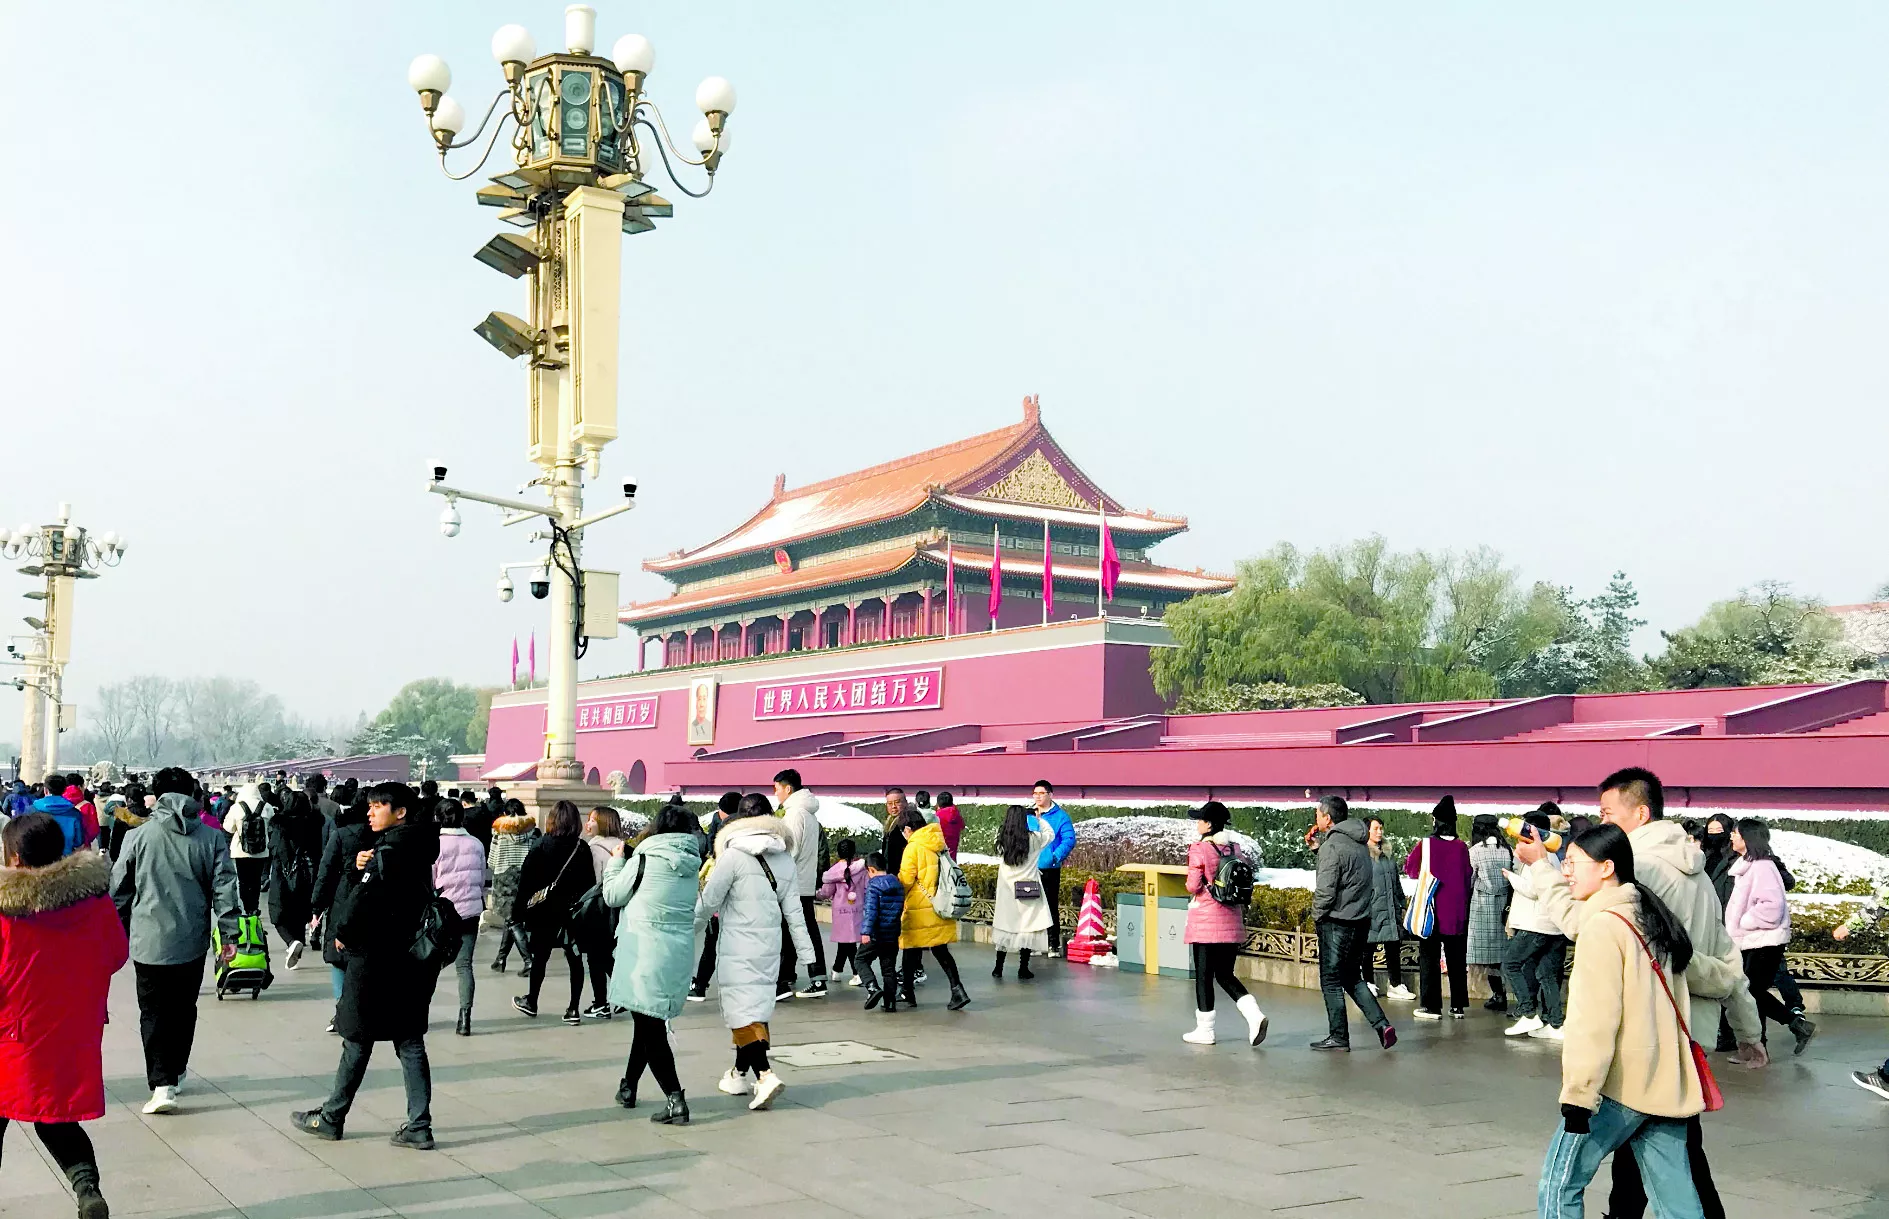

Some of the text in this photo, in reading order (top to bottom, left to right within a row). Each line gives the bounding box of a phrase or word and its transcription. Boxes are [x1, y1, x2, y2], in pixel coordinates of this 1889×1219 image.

[763, 676, 930, 713] 世界人民大团结万岁
[579, 703, 650, 727] 民共和国万岁
